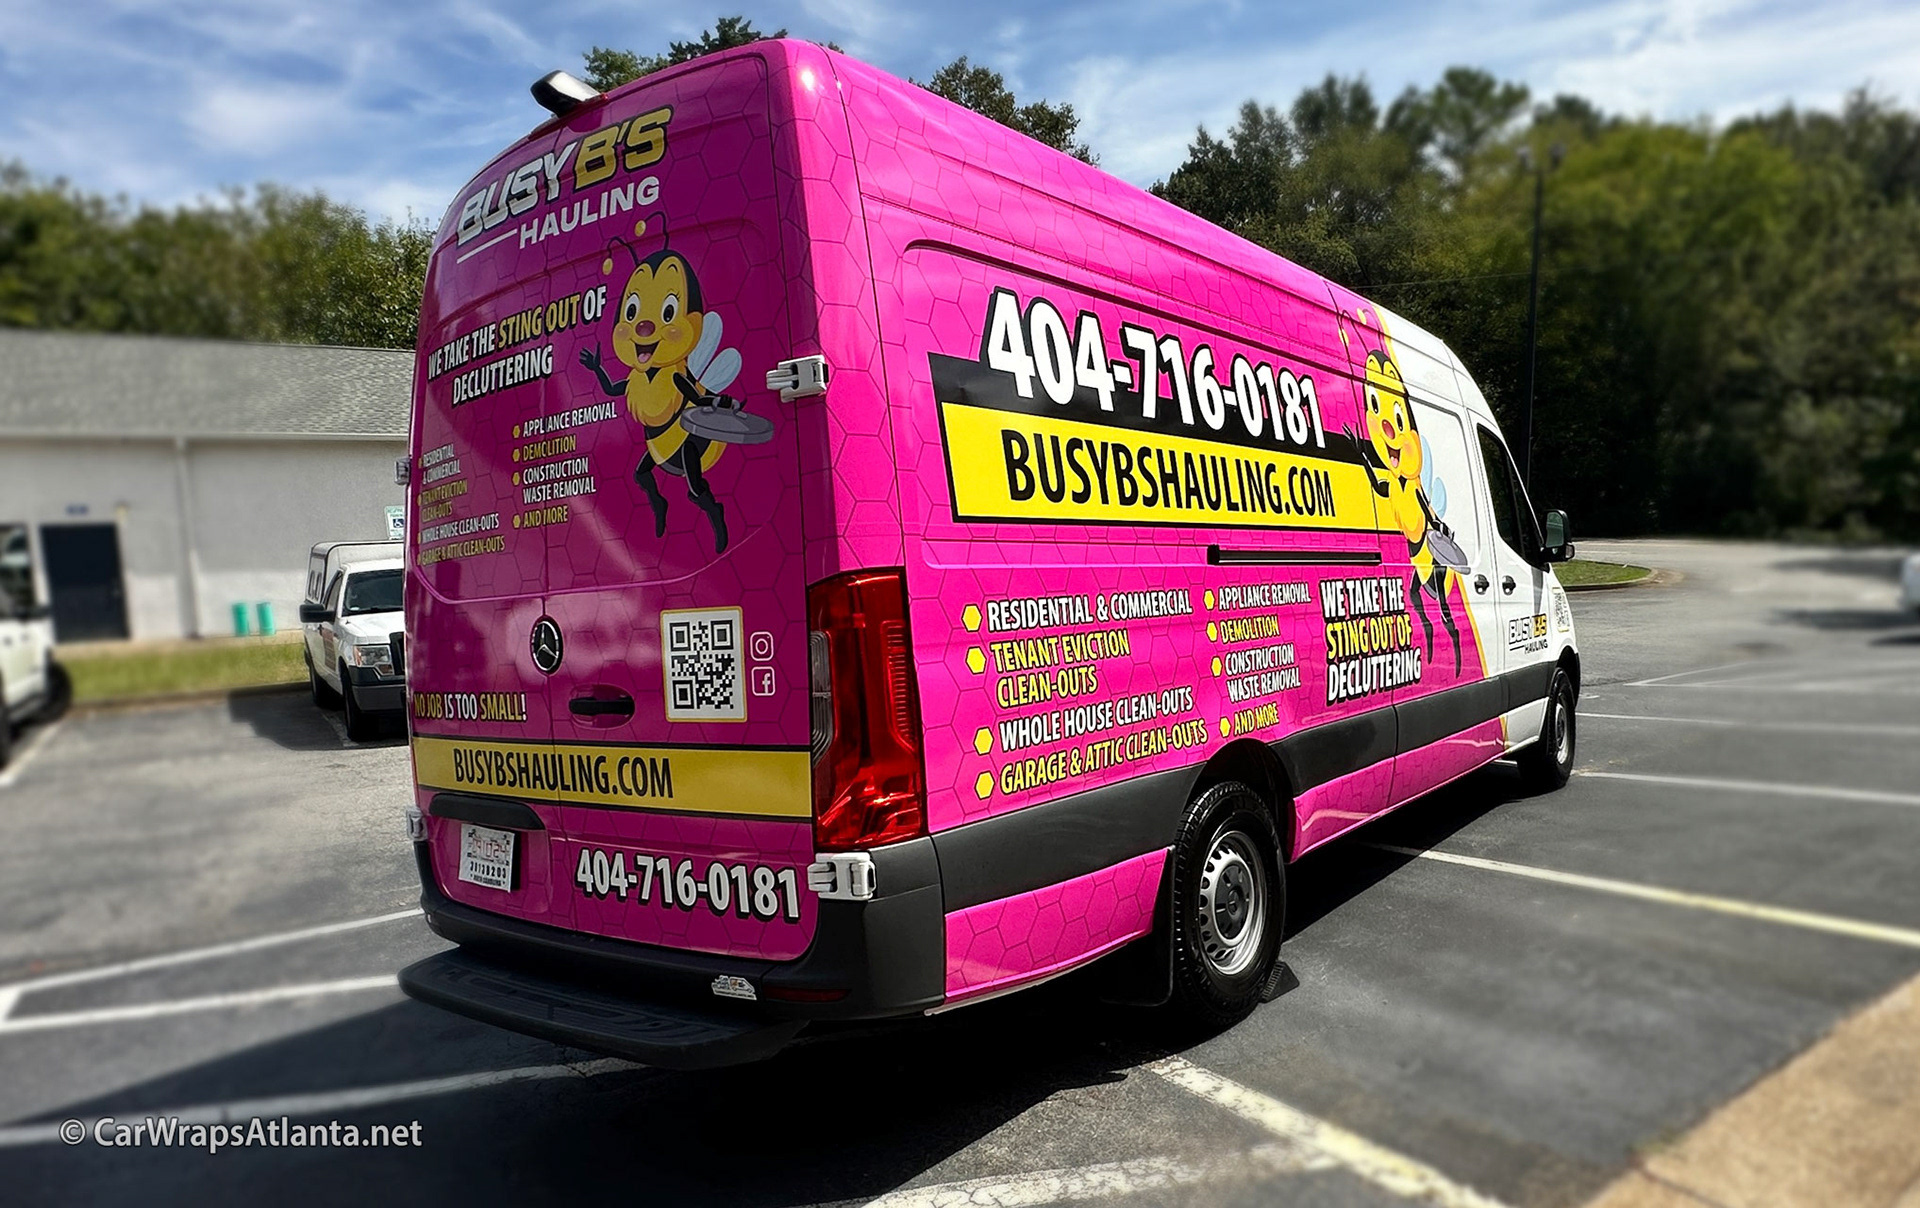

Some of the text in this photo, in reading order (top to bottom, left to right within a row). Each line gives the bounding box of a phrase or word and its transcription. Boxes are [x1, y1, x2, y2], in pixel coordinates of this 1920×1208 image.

[456, 106, 673, 248] BUSY B'S
[519, 176, 660, 250] HAULING
[428, 286, 607, 380] WE TAKE THE STING OUT OF
[453, 345, 553, 405] DECLUTTERING
[987, 291, 1326, 449] 404-716-0181
[523, 402, 617, 437] APPLIANCE REMOVAL
[523, 435, 576, 462] DEMOLITION
[523, 457, 589, 485] CONSTRUCTION
[523, 477, 597, 504] WASTE REMOVAL
[1001, 429, 1337, 518] BUSYBSHAULING.COM
[459, 513, 500, 535] CLEAN-OUTS
[523, 506, 568, 527] AND MORE
[463, 535, 505, 557] CLEAN-OUTS
[987, 590, 1193, 631] RESIDENTIAL & COMMERCIAL
[1218, 582, 1311, 610] APPLIANCE REMOVAL
[1320, 578, 1405, 618] WE TAKE THE
[1220, 616, 1280, 643] DEMOLITION
[1326, 614, 1412, 660] STING OUT OF
[991, 630, 1130, 673] TENANT EVICTION
[1225, 643, 1294, 676] CONSTRUCTION
[997, 666, 1098, 708] CLEAN-OUTS
[1226, 668, 1301, 703] WASTE REMOVAL
[1327, 648, 1422, 702] DECLUTTERING
[427, 693, 442, 718] JOB
[444, 693, 454, 719] IS
[455, 693, 478, 720] TOO
[480, 693, 527, 721] SMALL!
[999, 686, 1194, 752] WHOLE HOUSE CLEAN-OUTS
[1234, 702, 1279, 735] AND MORE
[453, 748, 674, 798] BUSYBSHAULING.COM
[1001, 720, 1208, 794] GARAGE & ATTIC CLEAN-OUTS
[577, 848, 801, 919] 404-716-0181
